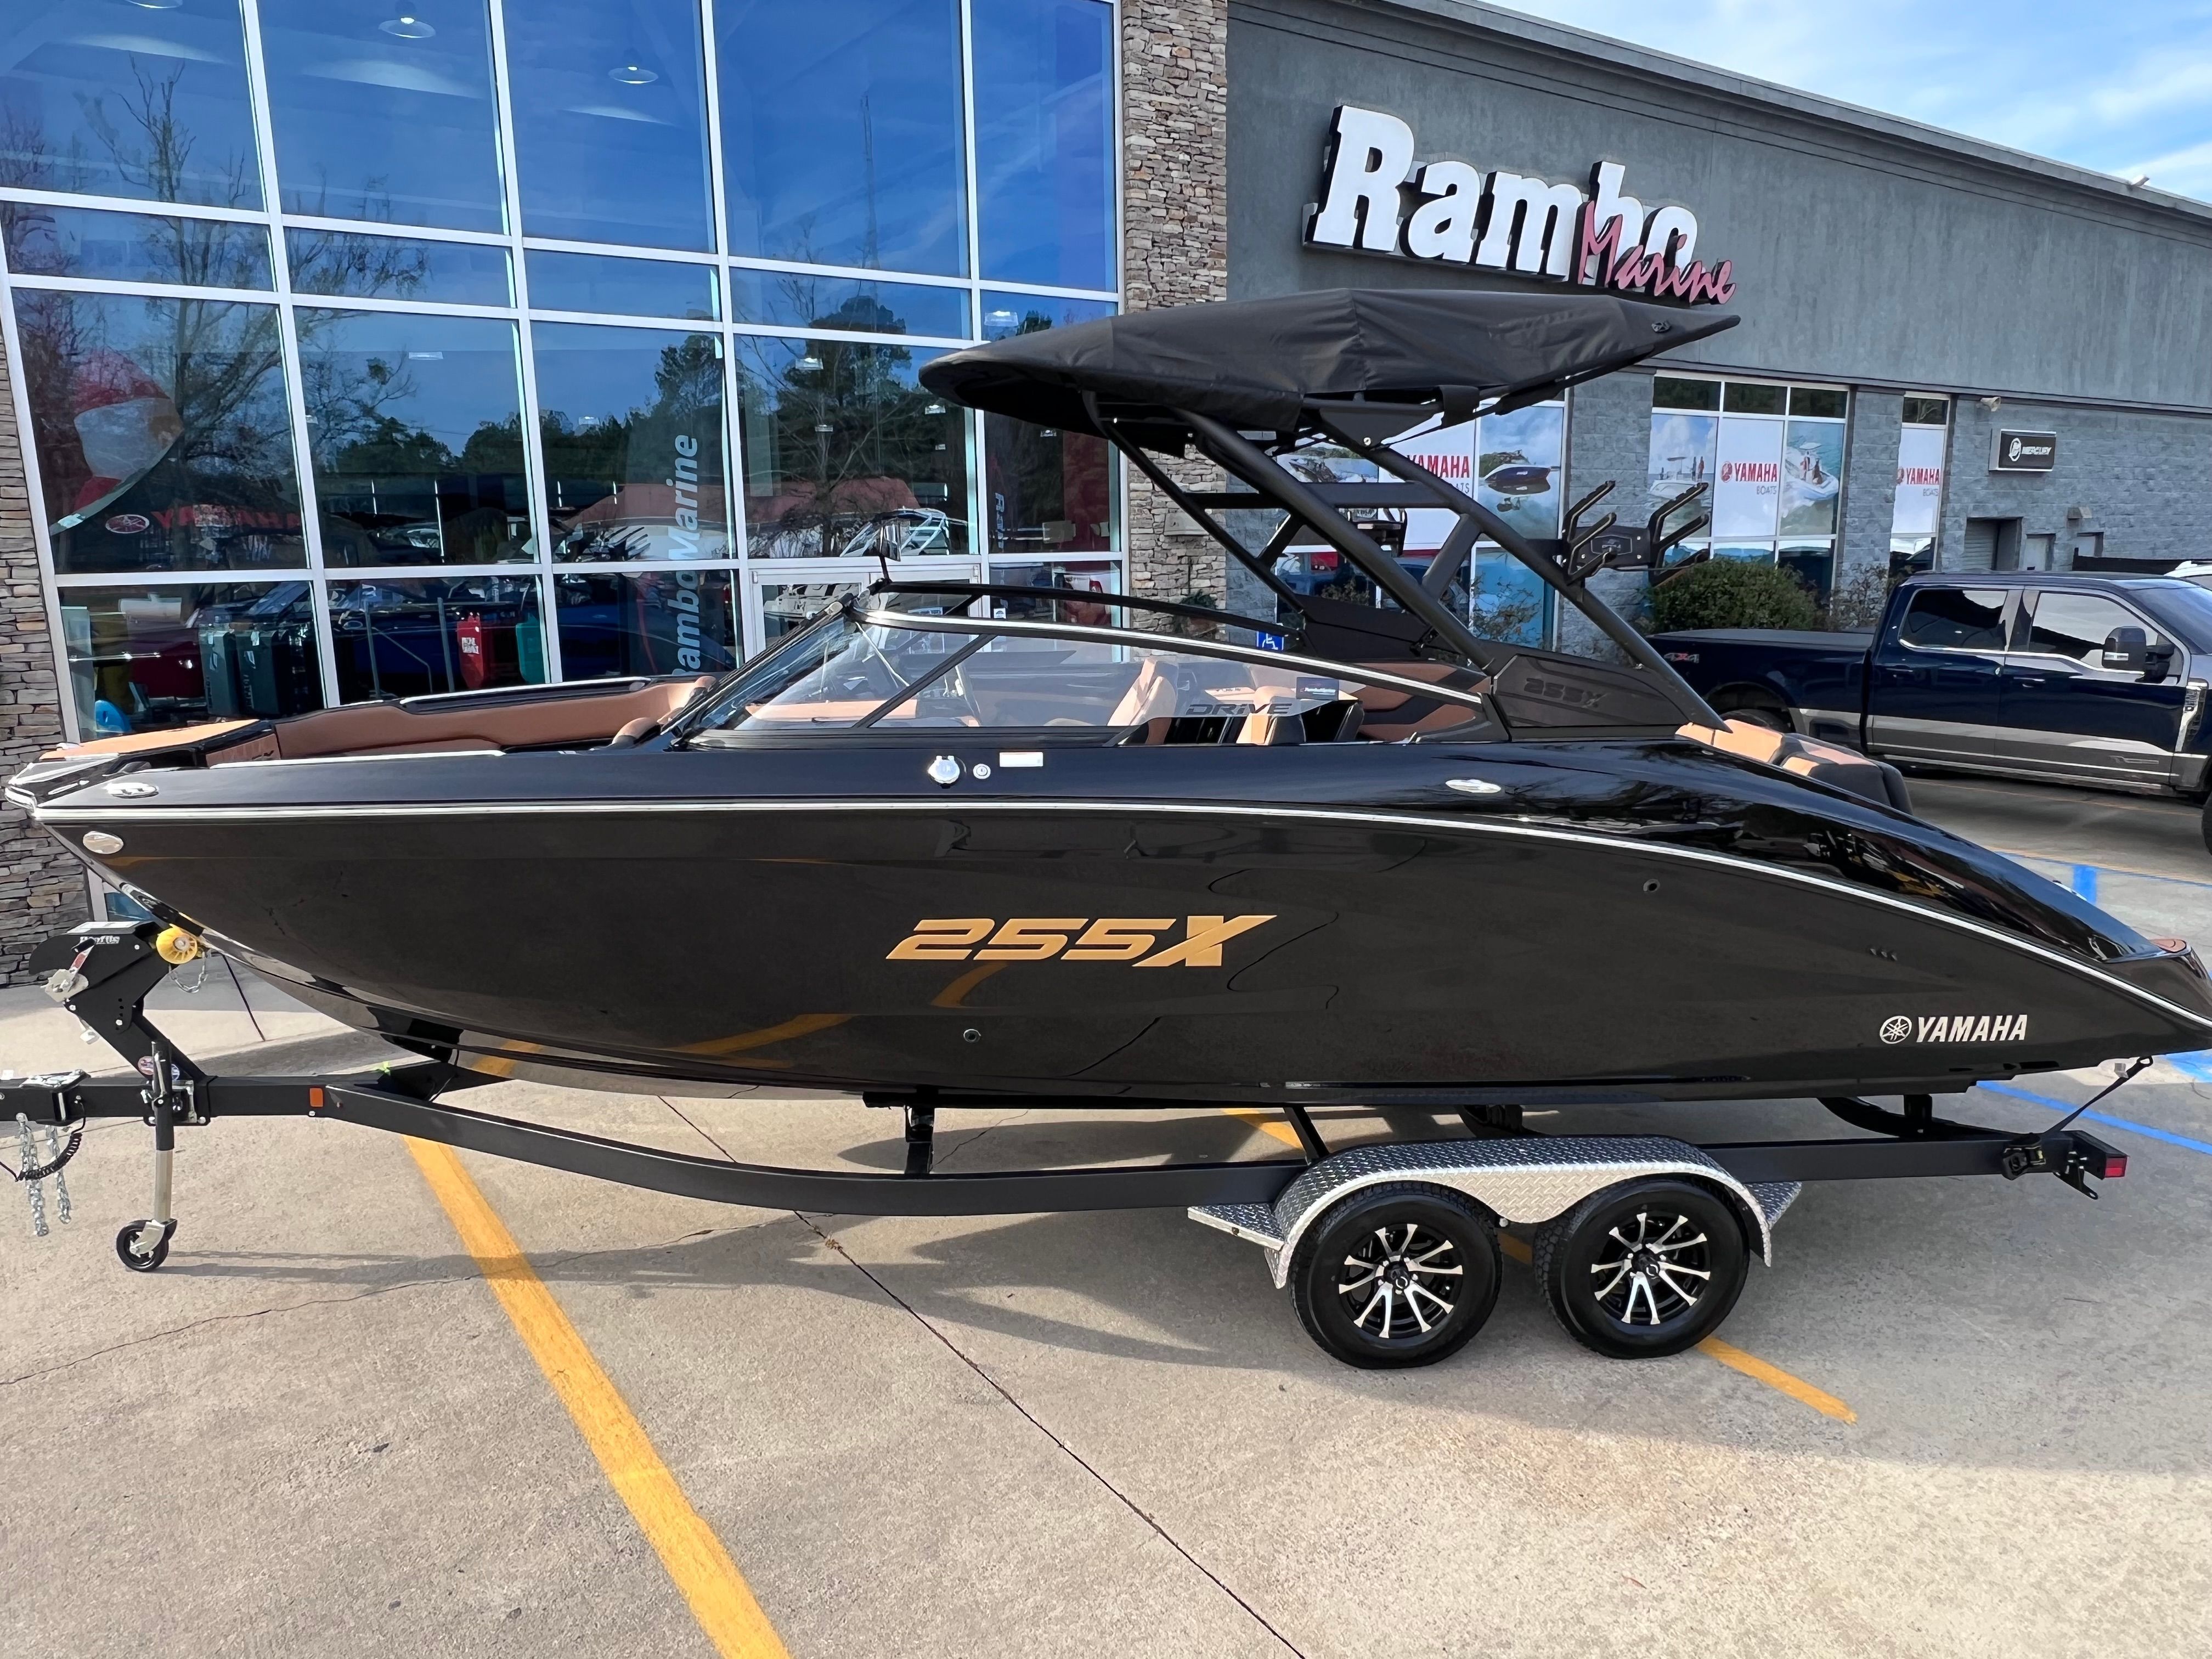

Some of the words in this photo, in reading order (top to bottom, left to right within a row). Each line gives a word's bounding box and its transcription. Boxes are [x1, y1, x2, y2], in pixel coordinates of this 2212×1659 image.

[1308, 104, 1699, 282] Rambo
[1577, 200, 1737, 305] Marine
[1734, 462, 1778, 482] YAMAHA
[1906, 467, 1940, 485] YAMAHA
[885, 915, 1278, 967] 255X
[1916, 1014, 2028, 1043] YAMAHA
